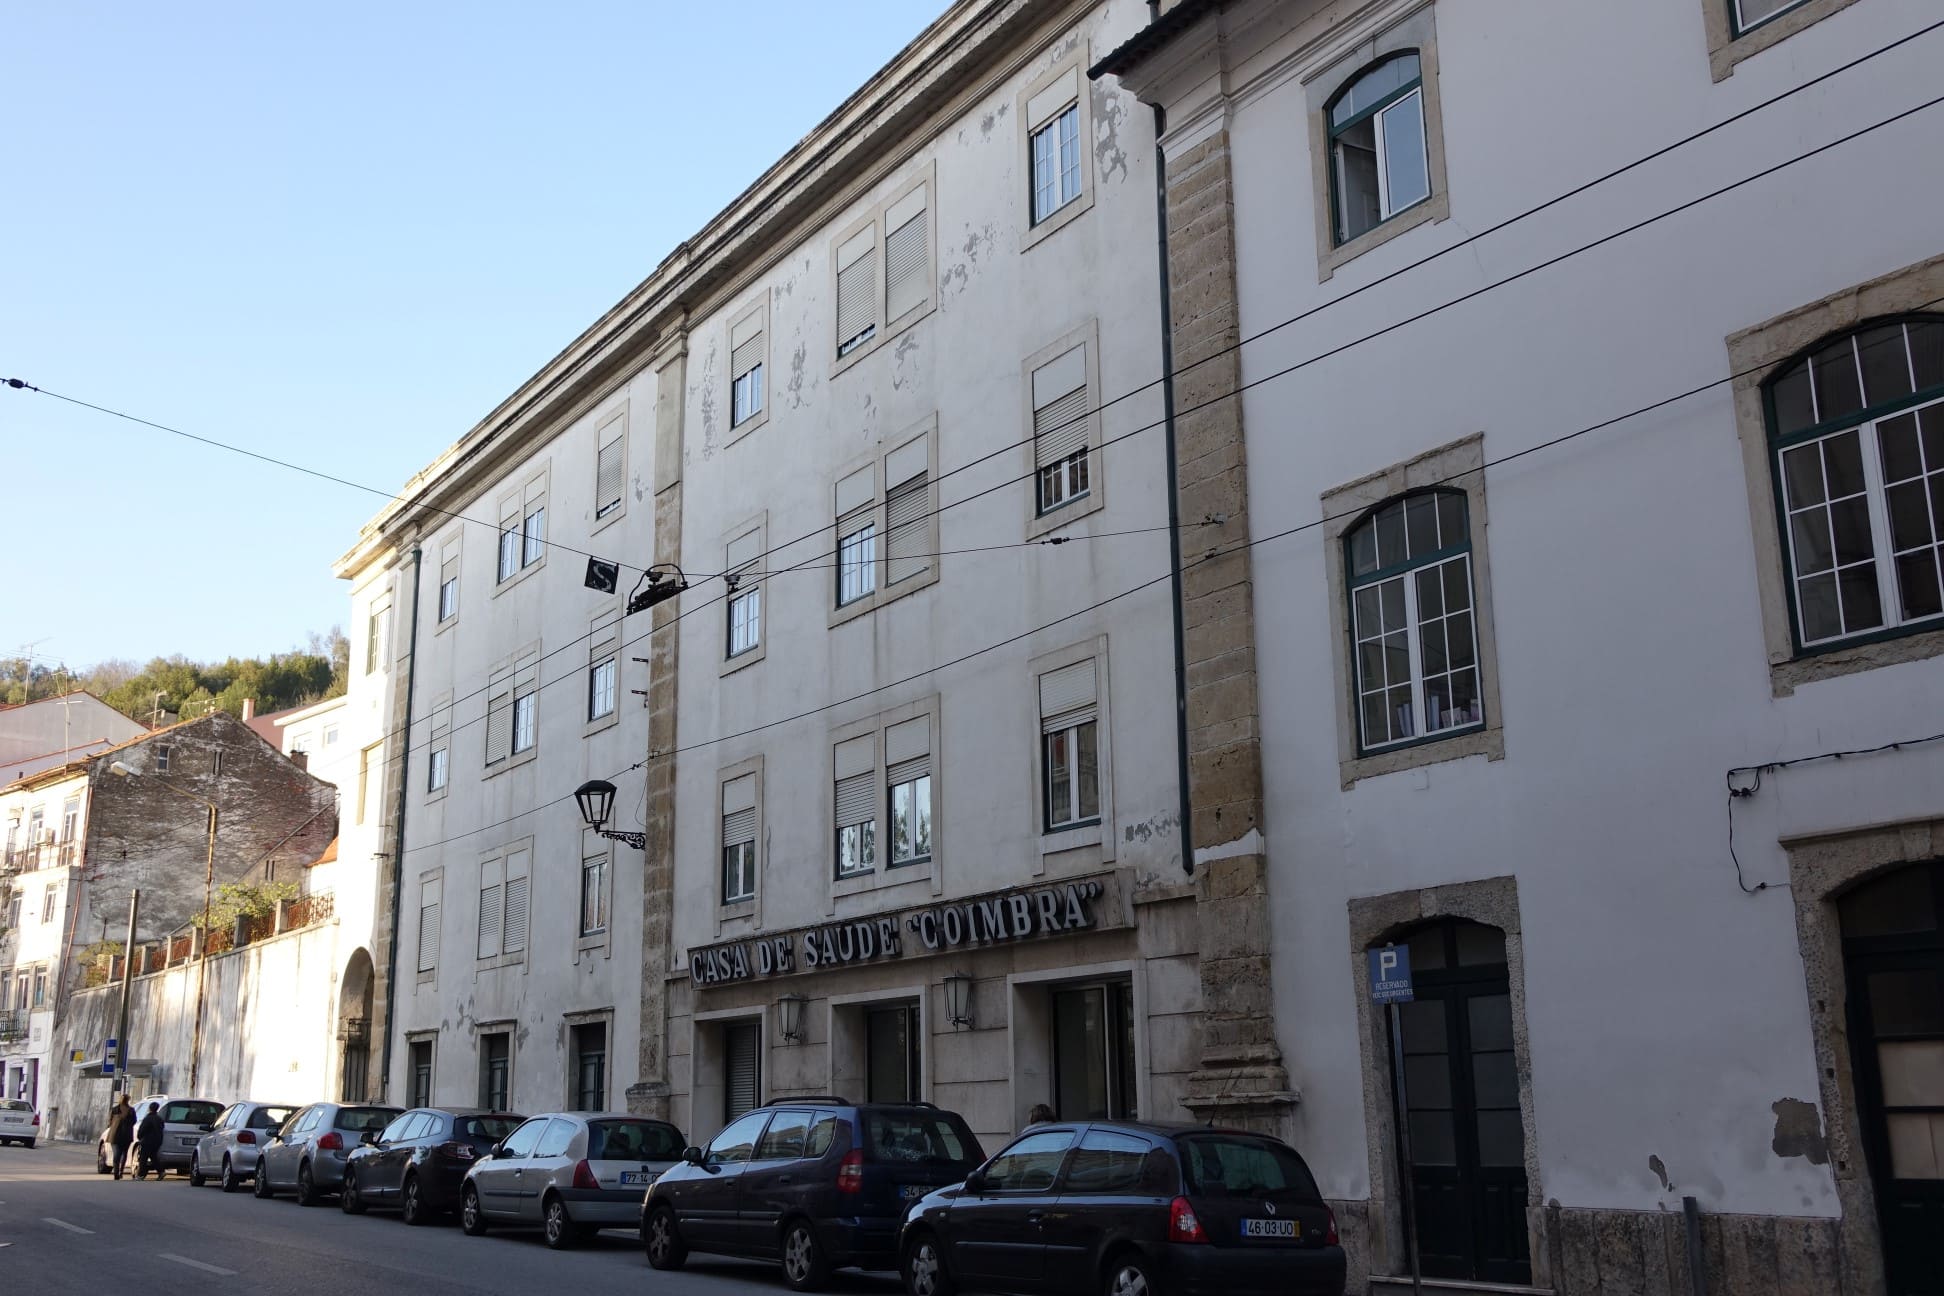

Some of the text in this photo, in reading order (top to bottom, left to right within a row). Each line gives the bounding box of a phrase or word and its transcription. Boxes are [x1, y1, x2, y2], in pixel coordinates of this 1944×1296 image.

[691, 944, 748, 984] CASA
[757, 937, 793, 974] DE
[803, 918, 898, 967] SAUDE
[1380, 951, 1397, 982] P
